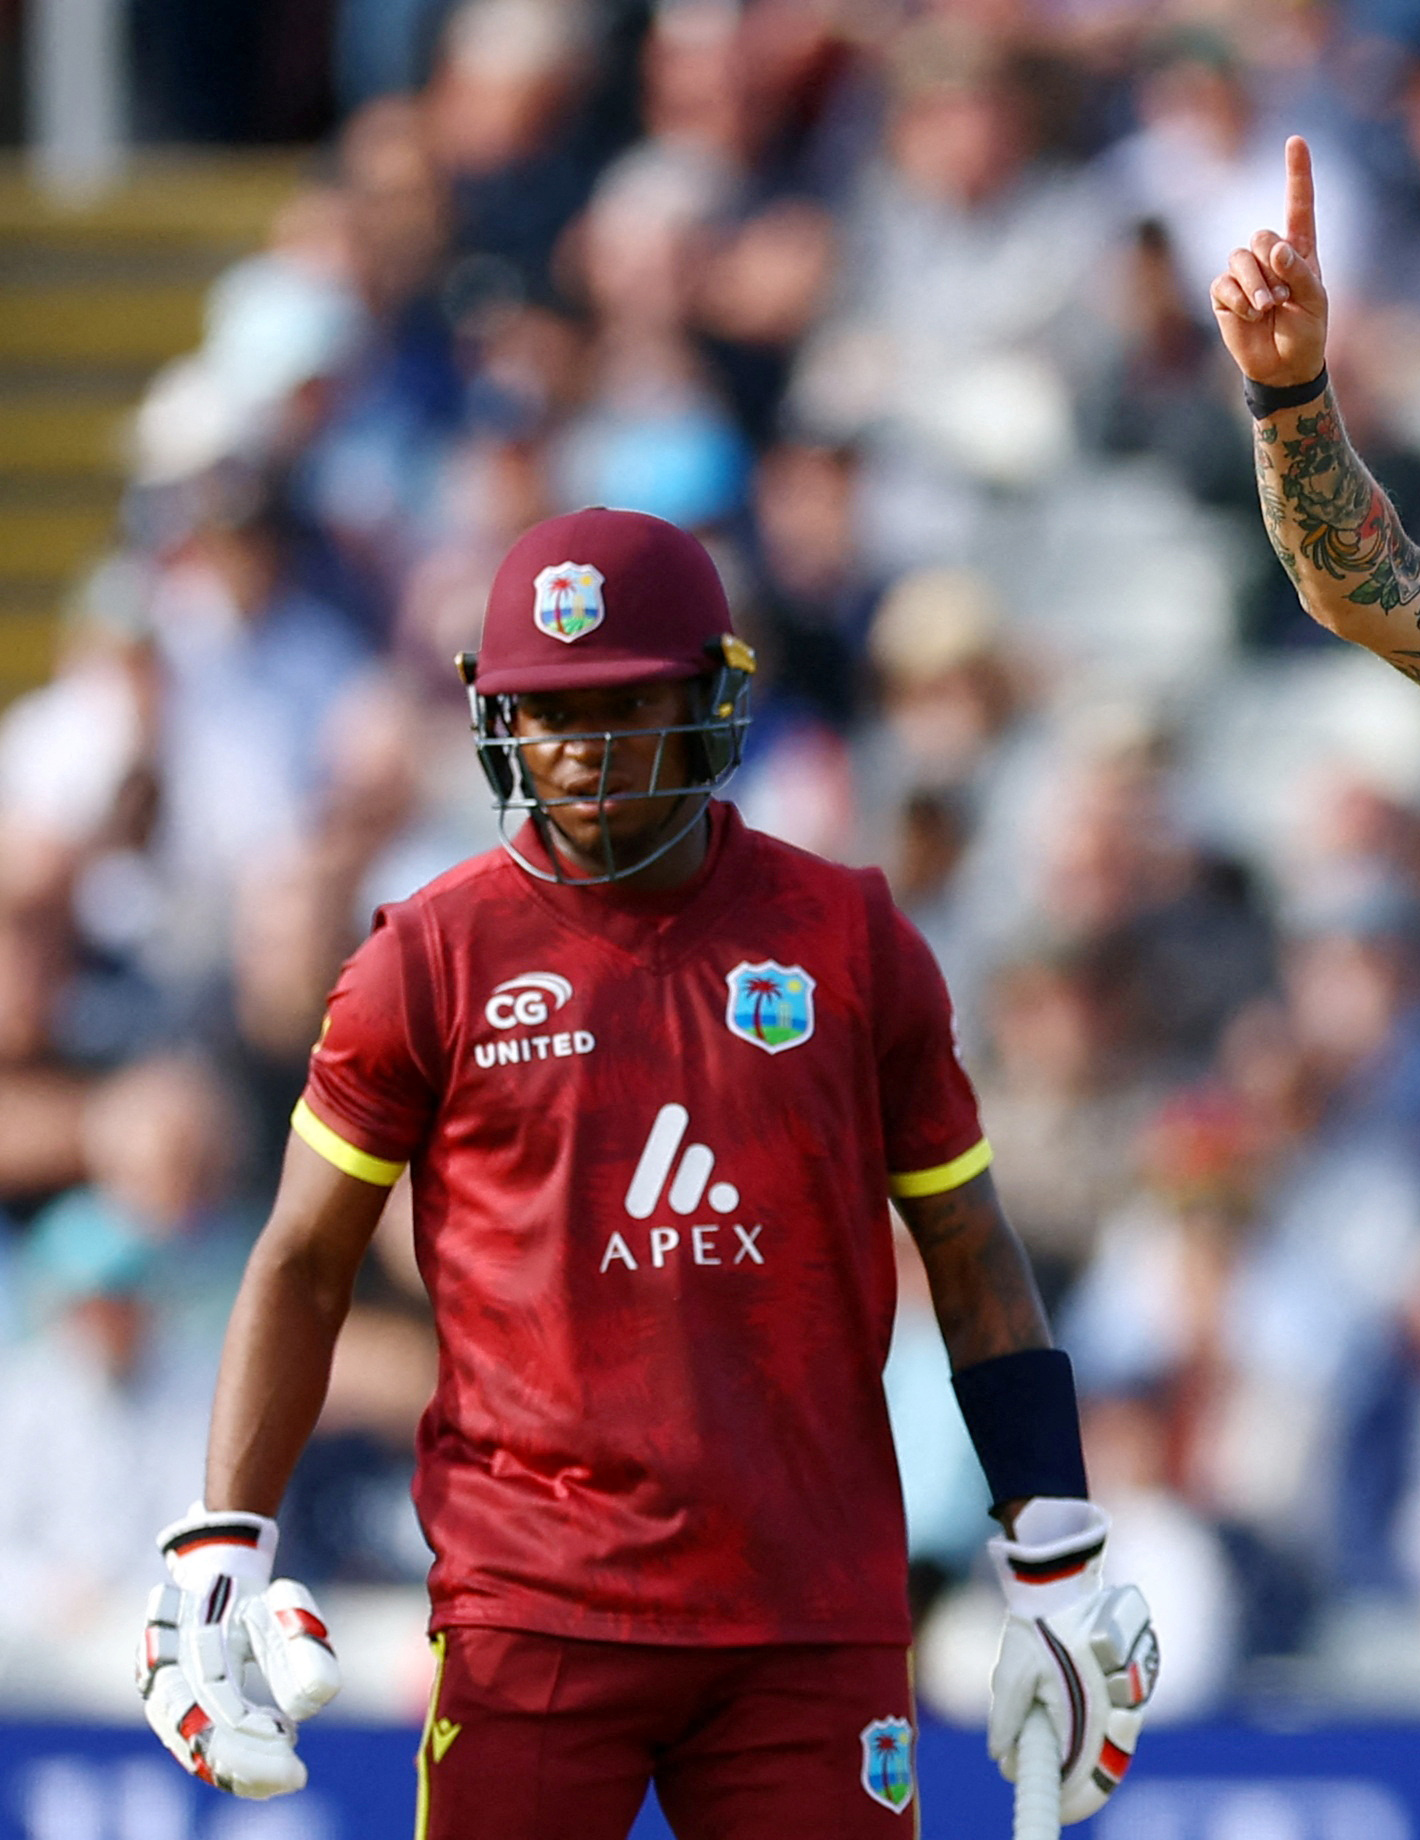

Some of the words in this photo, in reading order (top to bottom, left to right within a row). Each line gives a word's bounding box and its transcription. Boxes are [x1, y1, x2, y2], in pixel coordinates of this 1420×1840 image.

[485, 990, 549, 1030] CG
[474, 1029, 596, 1069] UNITED
[599, 1223, 765, 1274] APEX
